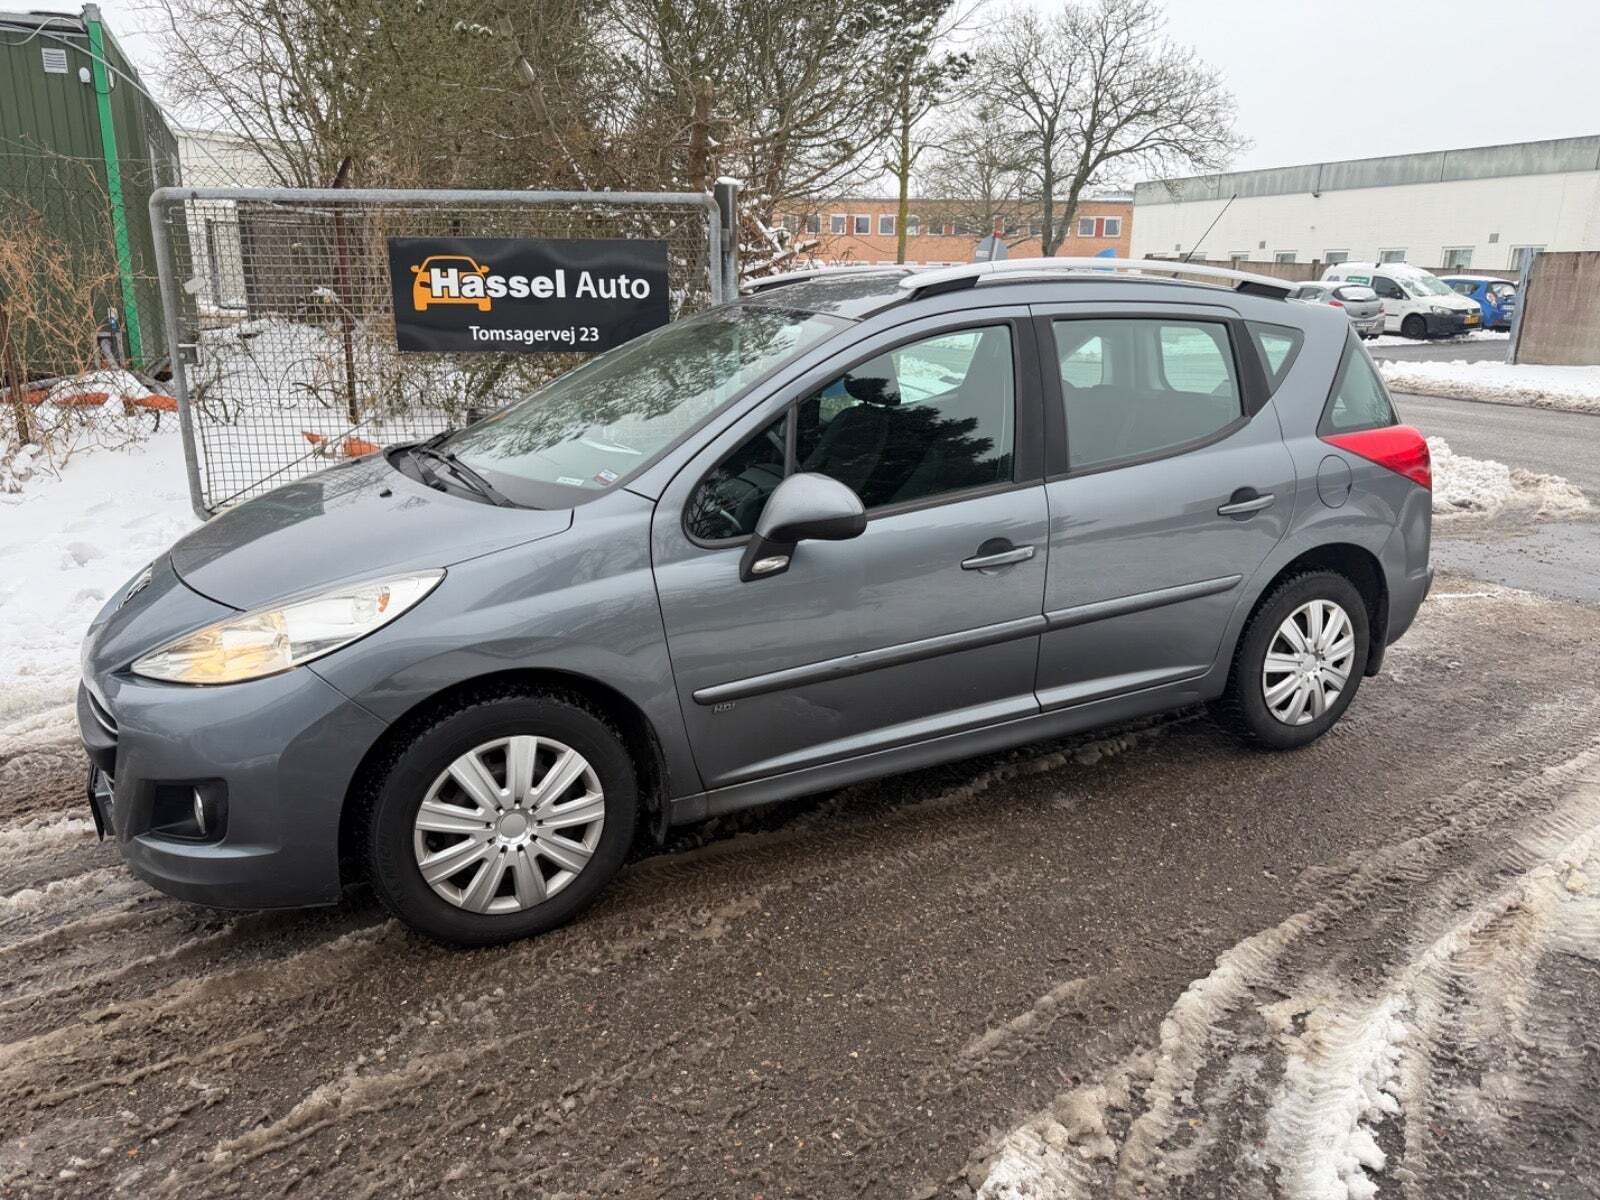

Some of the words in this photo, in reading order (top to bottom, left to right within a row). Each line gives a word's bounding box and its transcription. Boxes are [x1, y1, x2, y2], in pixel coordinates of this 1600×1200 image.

[430, 268, 566, 298] Hassel
[575, 271, 650, 299] Auto
[469, 325, 576, 344] Tomsagervej
[579, 327, 599, 342] 23
